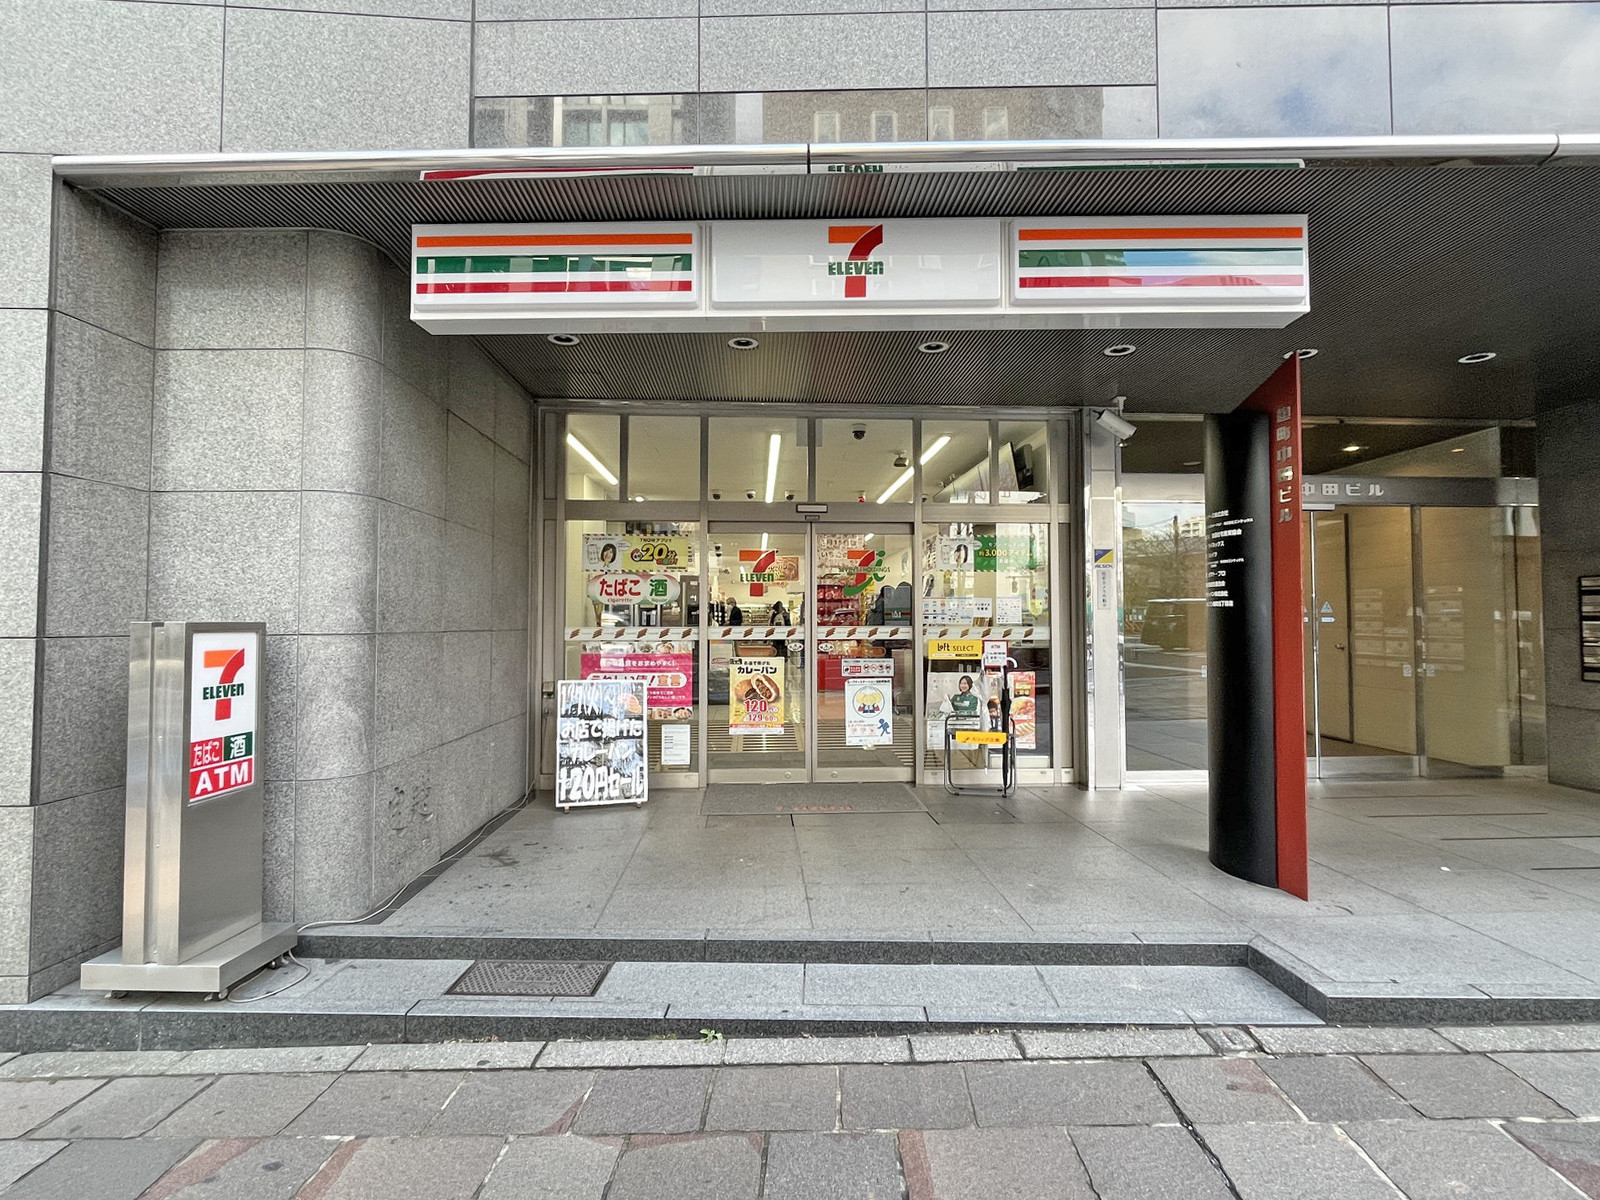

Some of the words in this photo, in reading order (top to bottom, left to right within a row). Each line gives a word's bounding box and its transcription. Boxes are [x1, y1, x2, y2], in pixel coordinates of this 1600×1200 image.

[599, 578, 641, 597] たばこ
[649, 579, 667, 597] 酒
[744, 700, 767, 712] 120
[193, 740, 220, 767] たばこ
[230, 735, 247, 759] 酒
[195, 761, 249, 795] ATM
